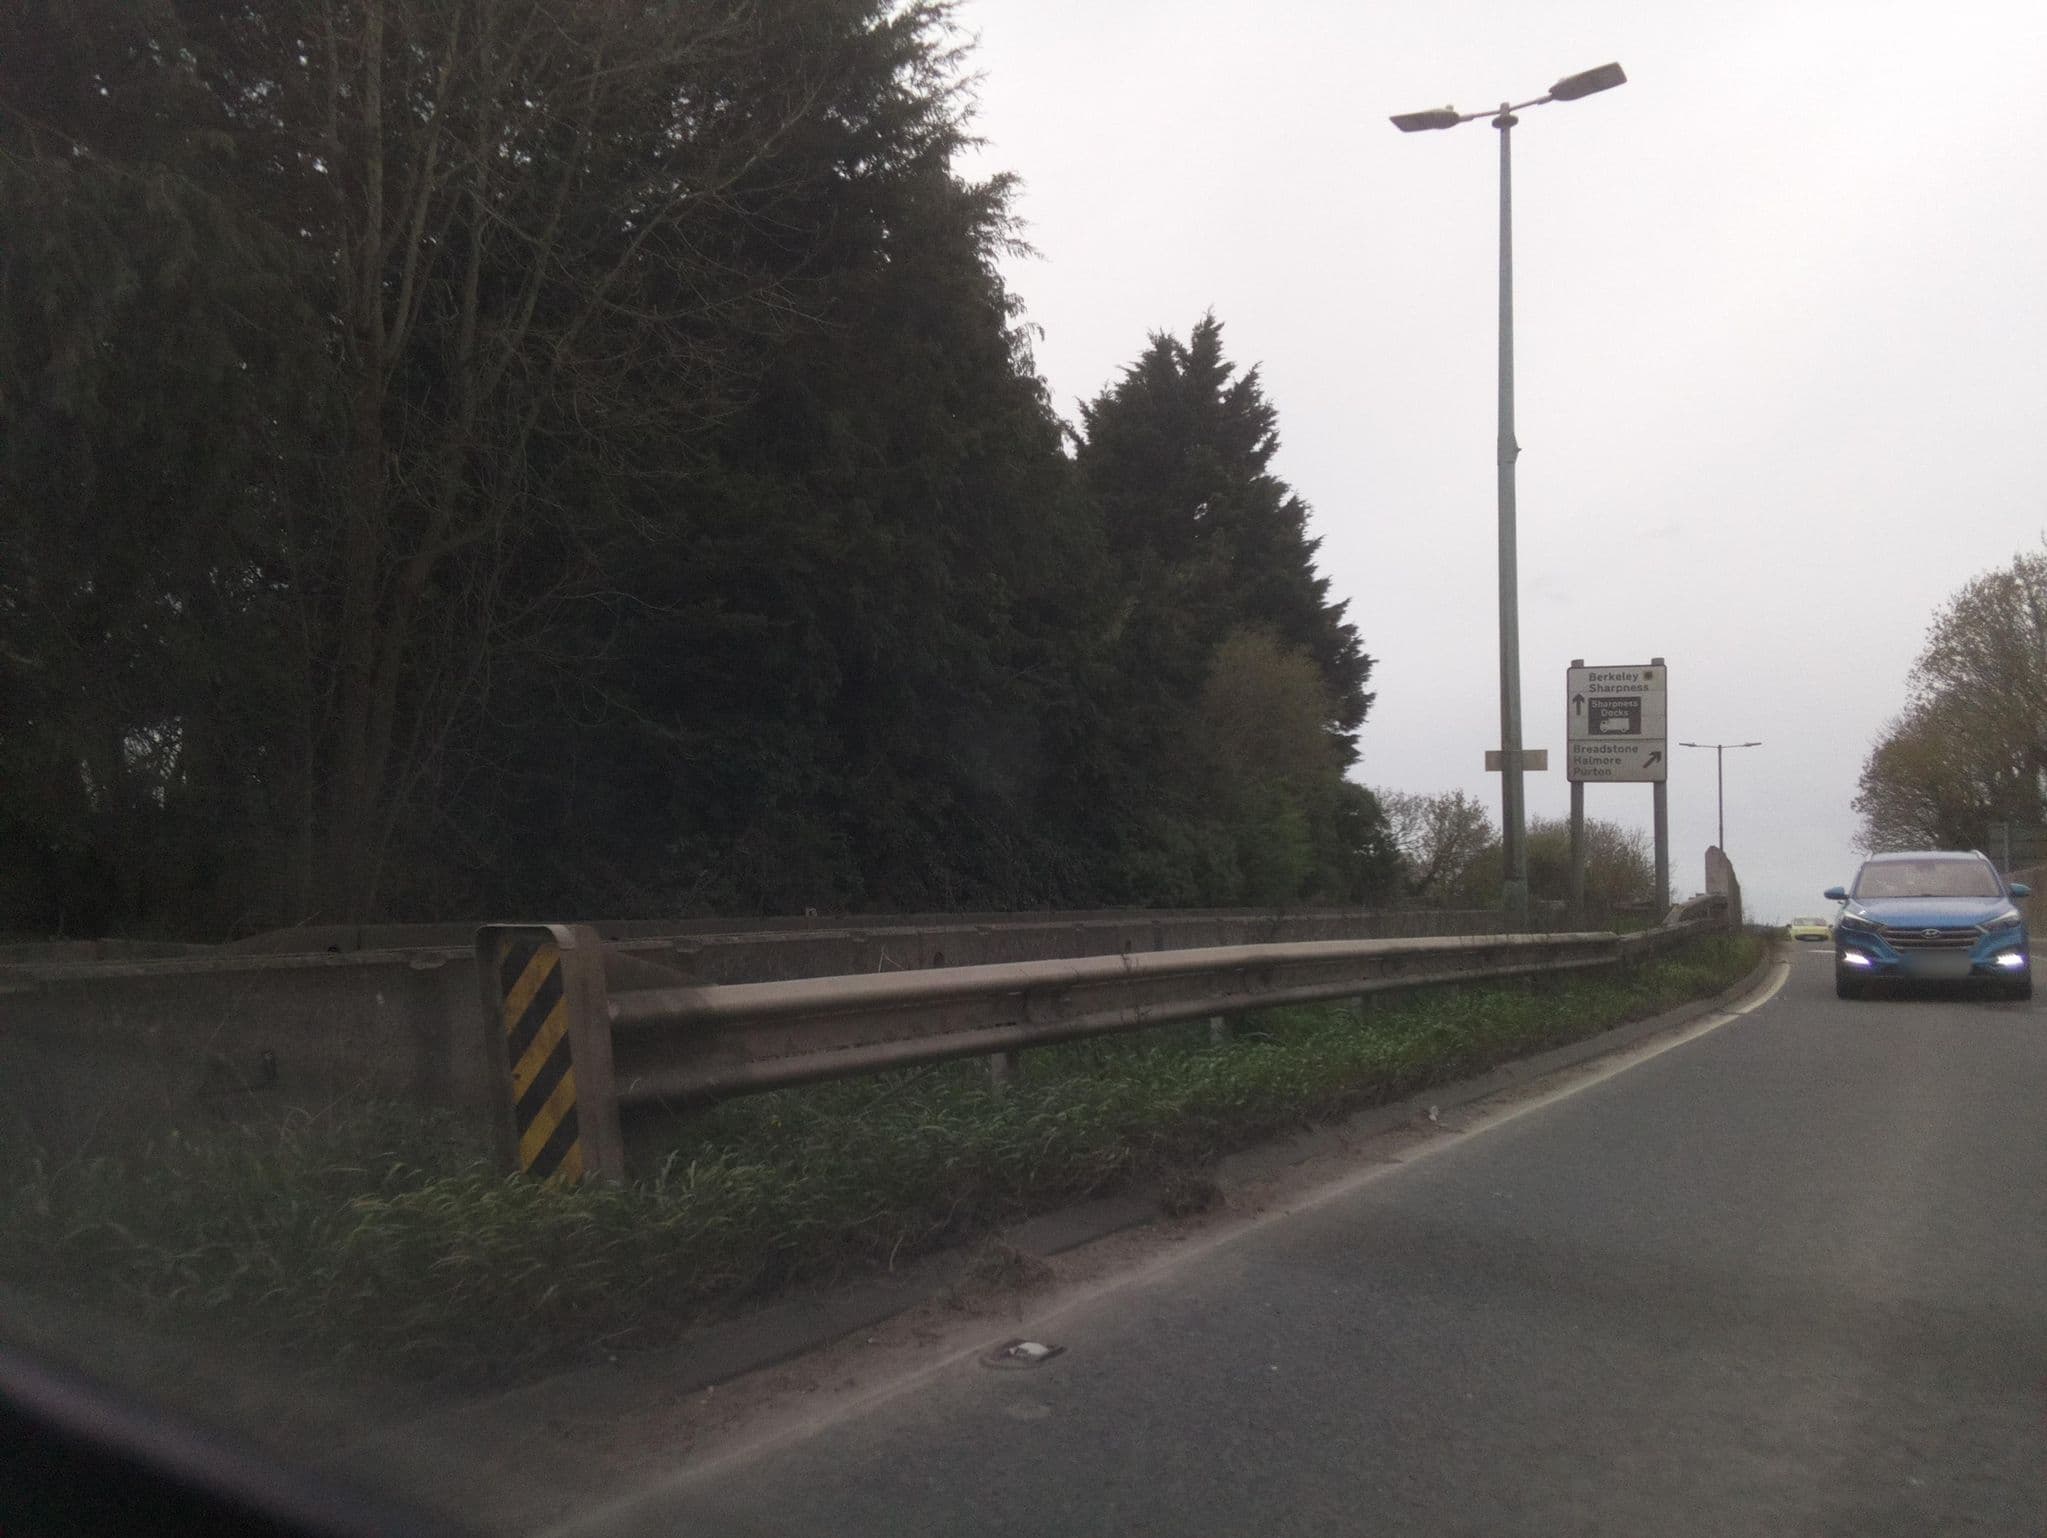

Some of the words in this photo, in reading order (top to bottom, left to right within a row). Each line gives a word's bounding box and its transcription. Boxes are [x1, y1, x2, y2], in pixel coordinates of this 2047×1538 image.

[1589, 672, 1639, 683] Berkeley
[1589, 683, 1649, 694] Sharpness
[1591, 699, 1639, 709] Sharpness
[1601, 709, 1629, 717] Docks
[1573, 744, 1639, 754] Breadstone
[1573, 755, 1622, 765] Halmore
[1573, 767, 1612, 777] Purton
